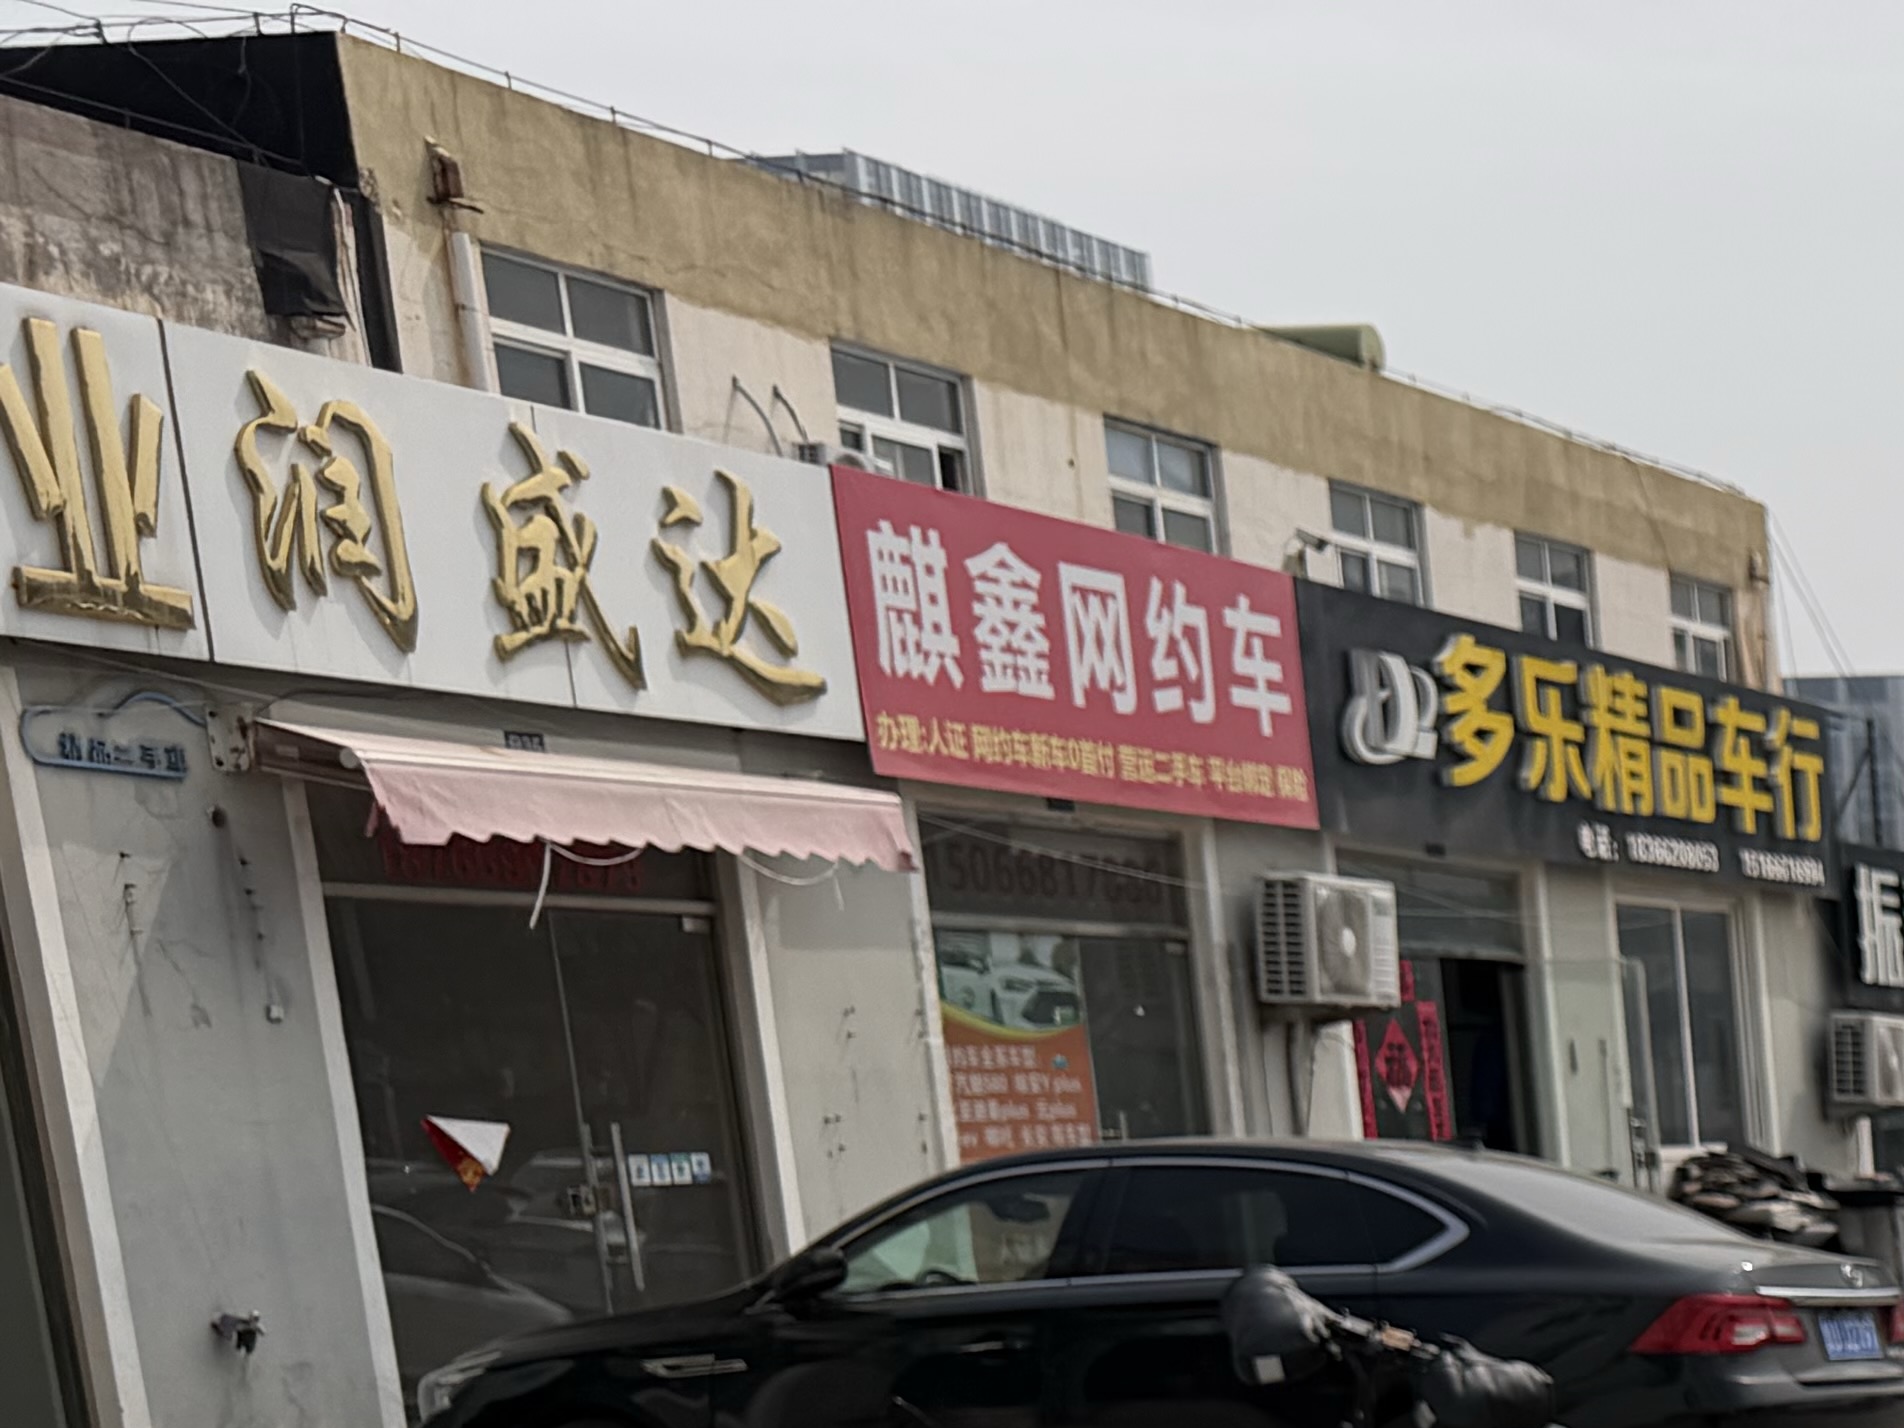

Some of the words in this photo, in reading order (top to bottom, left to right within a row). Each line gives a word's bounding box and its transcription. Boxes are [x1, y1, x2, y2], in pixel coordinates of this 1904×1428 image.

[866, 519, 1292, 737] 麒鑫网约车
[1436, 632, 1825, 842] 多乐精品车行
